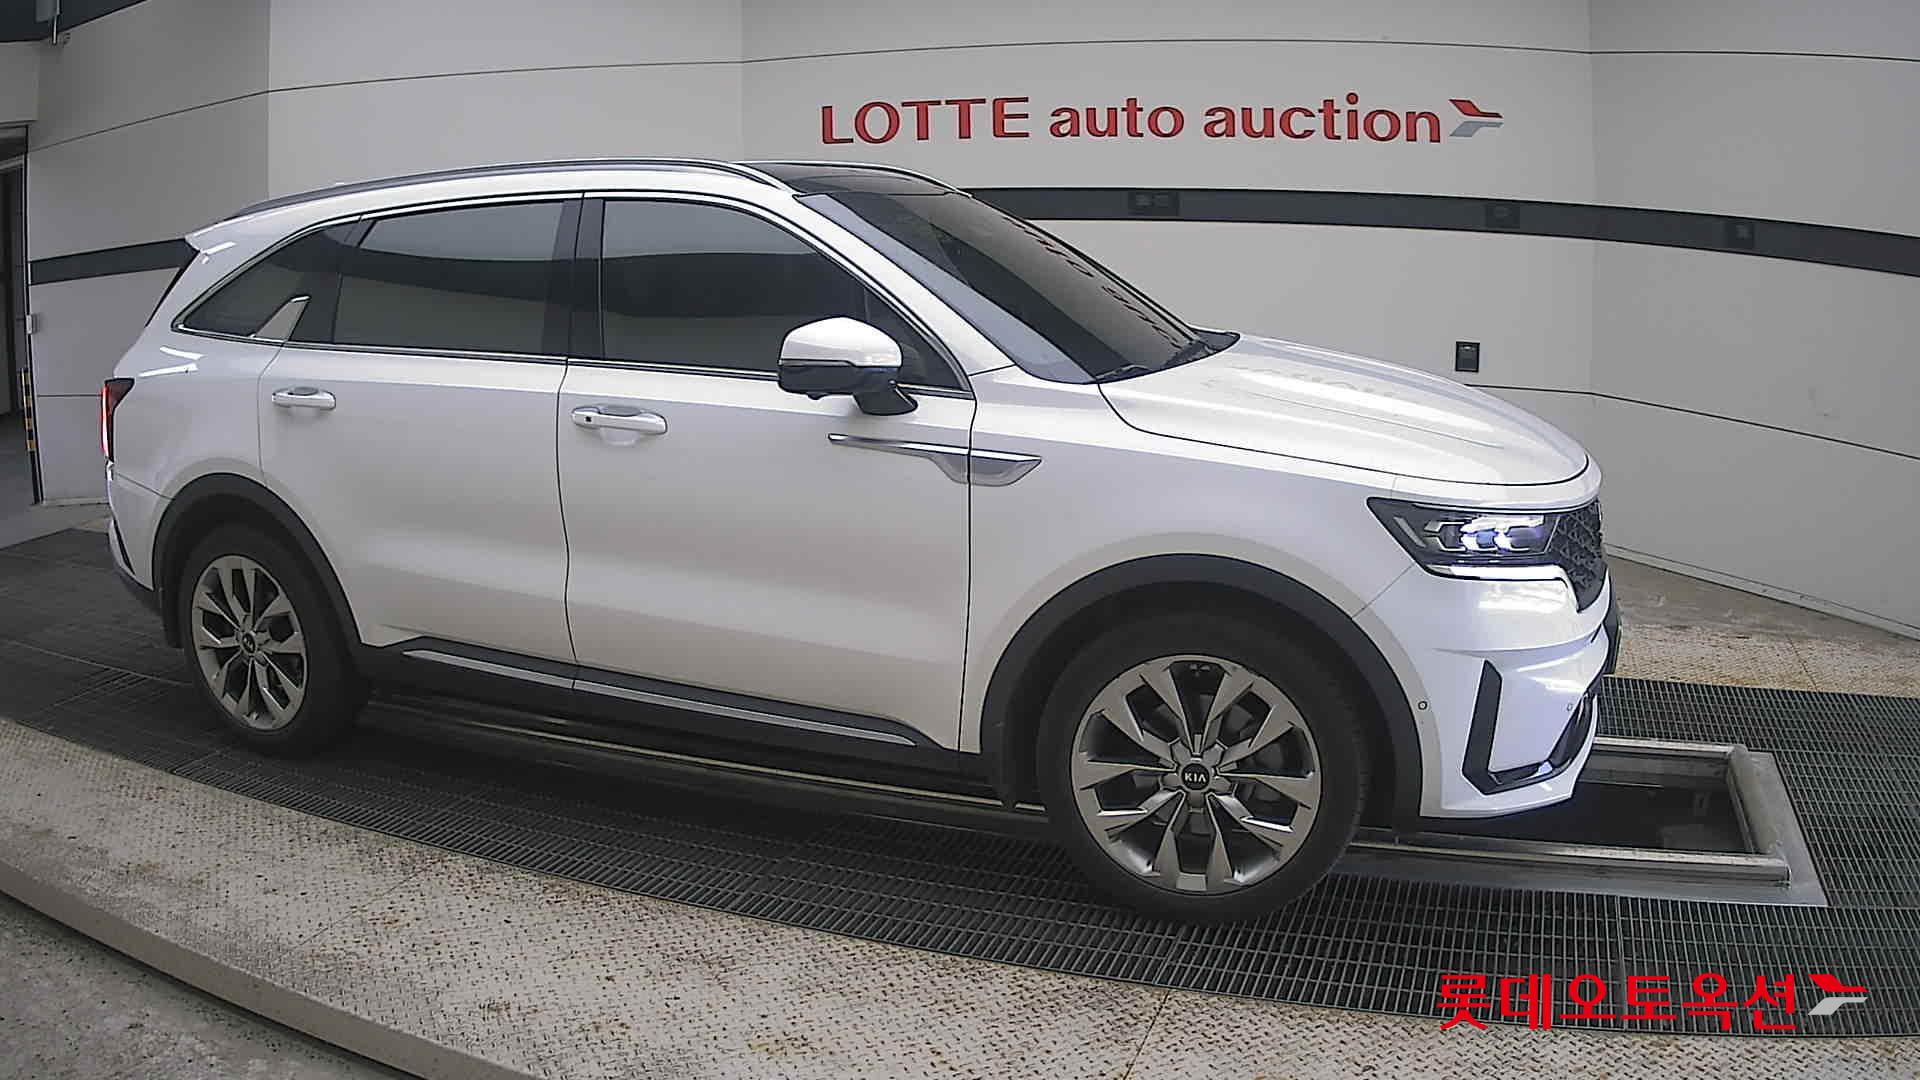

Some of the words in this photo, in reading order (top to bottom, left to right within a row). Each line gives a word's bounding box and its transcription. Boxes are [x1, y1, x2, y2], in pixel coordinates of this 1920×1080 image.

[821, 97, 1029, 144] LOTTE
[1049, 98, 1185, 138] auto
[1203, 93, 1441, 142] auction
[1184, 772, 1206, 782] KIA
